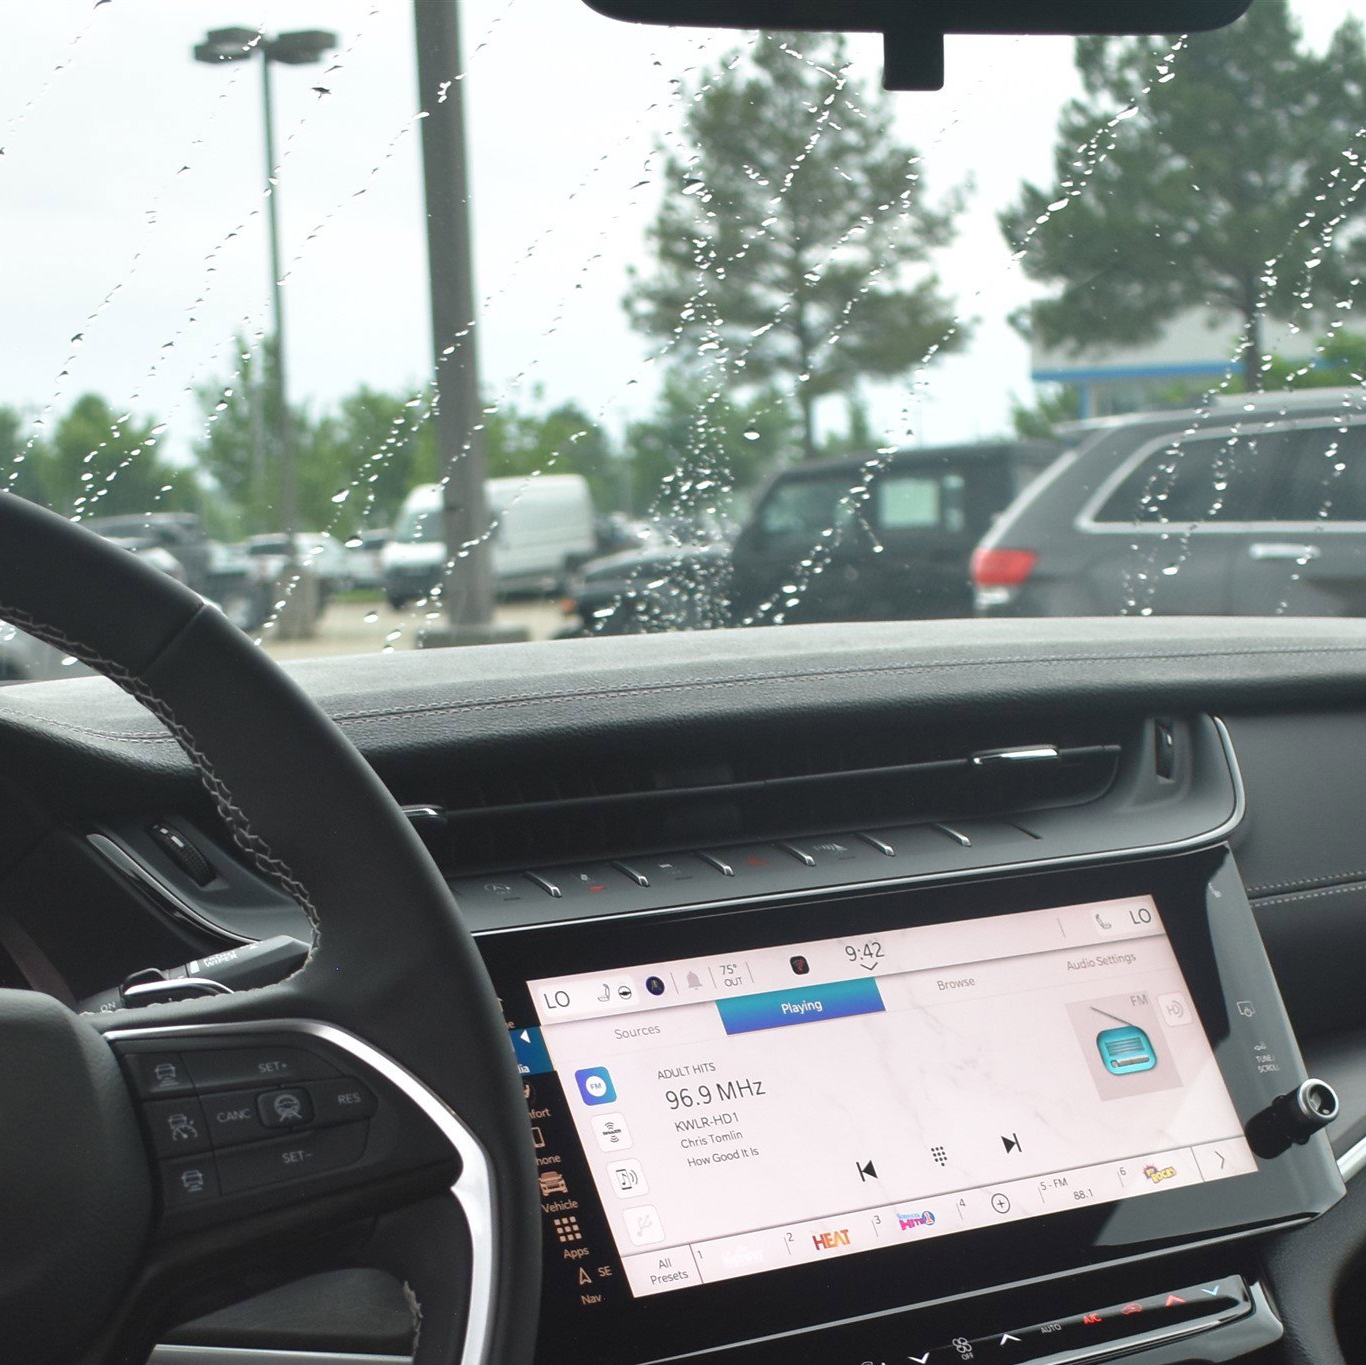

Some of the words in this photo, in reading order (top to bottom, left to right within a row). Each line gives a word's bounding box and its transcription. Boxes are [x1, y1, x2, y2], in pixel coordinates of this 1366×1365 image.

[1129, 907, 1152, 925] LO
[845, 941, 885, 962] 9:42
[1066, 957, 1096, 972] Audio
[1096, 951, 1137, 968] Settings
[724, 976, 743, 988] OUT
[936, 976, 976, 991] Browse
[543, 990, 571, 1009] LO
[781, 998, 823, 1015] Playing
[1130, 993, 1149, 1007] FM
[614, 1024, 661, 1040] Sources
[657, 1065, 691, 1080] ADULT
[692, 1062, 716, 1074] HITS
[589, 1083, 602, 1091] FM
[665, 1085, 712, 1110] 96.9
[715, 1078, 766, 1101] MHz
[337, 1092, 362, 1105] RES
[217, 1108, 252, 1124] CANC
[674, 1112, 739, 1133] KWLR-HD1
[680, 1136, 708, 1149] Chris
[708, 1130, 743, 1145] Tomlin
[536, 1154, 562, 1165] hone
[687, 1156, 711, 1167] How
[711, 1149, 740, 1163] Good
[1119, 1166, 1127, 1177] 6
[1039, 1181, 1047, 1191] 5
[1053, 1177, 1068, 1189] FM
[1073, 1188, 1094, 1201] 88.1
[541, 1198, 579, 1214] Vehicle
[958, 1198, 966, 1208] 4
[873, 1215, 882, 1225] 3
[786, 1232, 795, 1242] 2
[812, 1228, 851, 1250] HEAT
[563, 1246, 590, 1261] Apps
[597, 1265, 613, 1277] SE
[658, 1258, 672, 1270] All
[650, 1269, 689, 1285] Presets
[580, 1292, 602, 1305] Nav
[1083, 1312, 1102, 1325] A/C
[1040, 1323, 1062, 1335] AUTO
[961, 1352, 975, 1362] OFF
